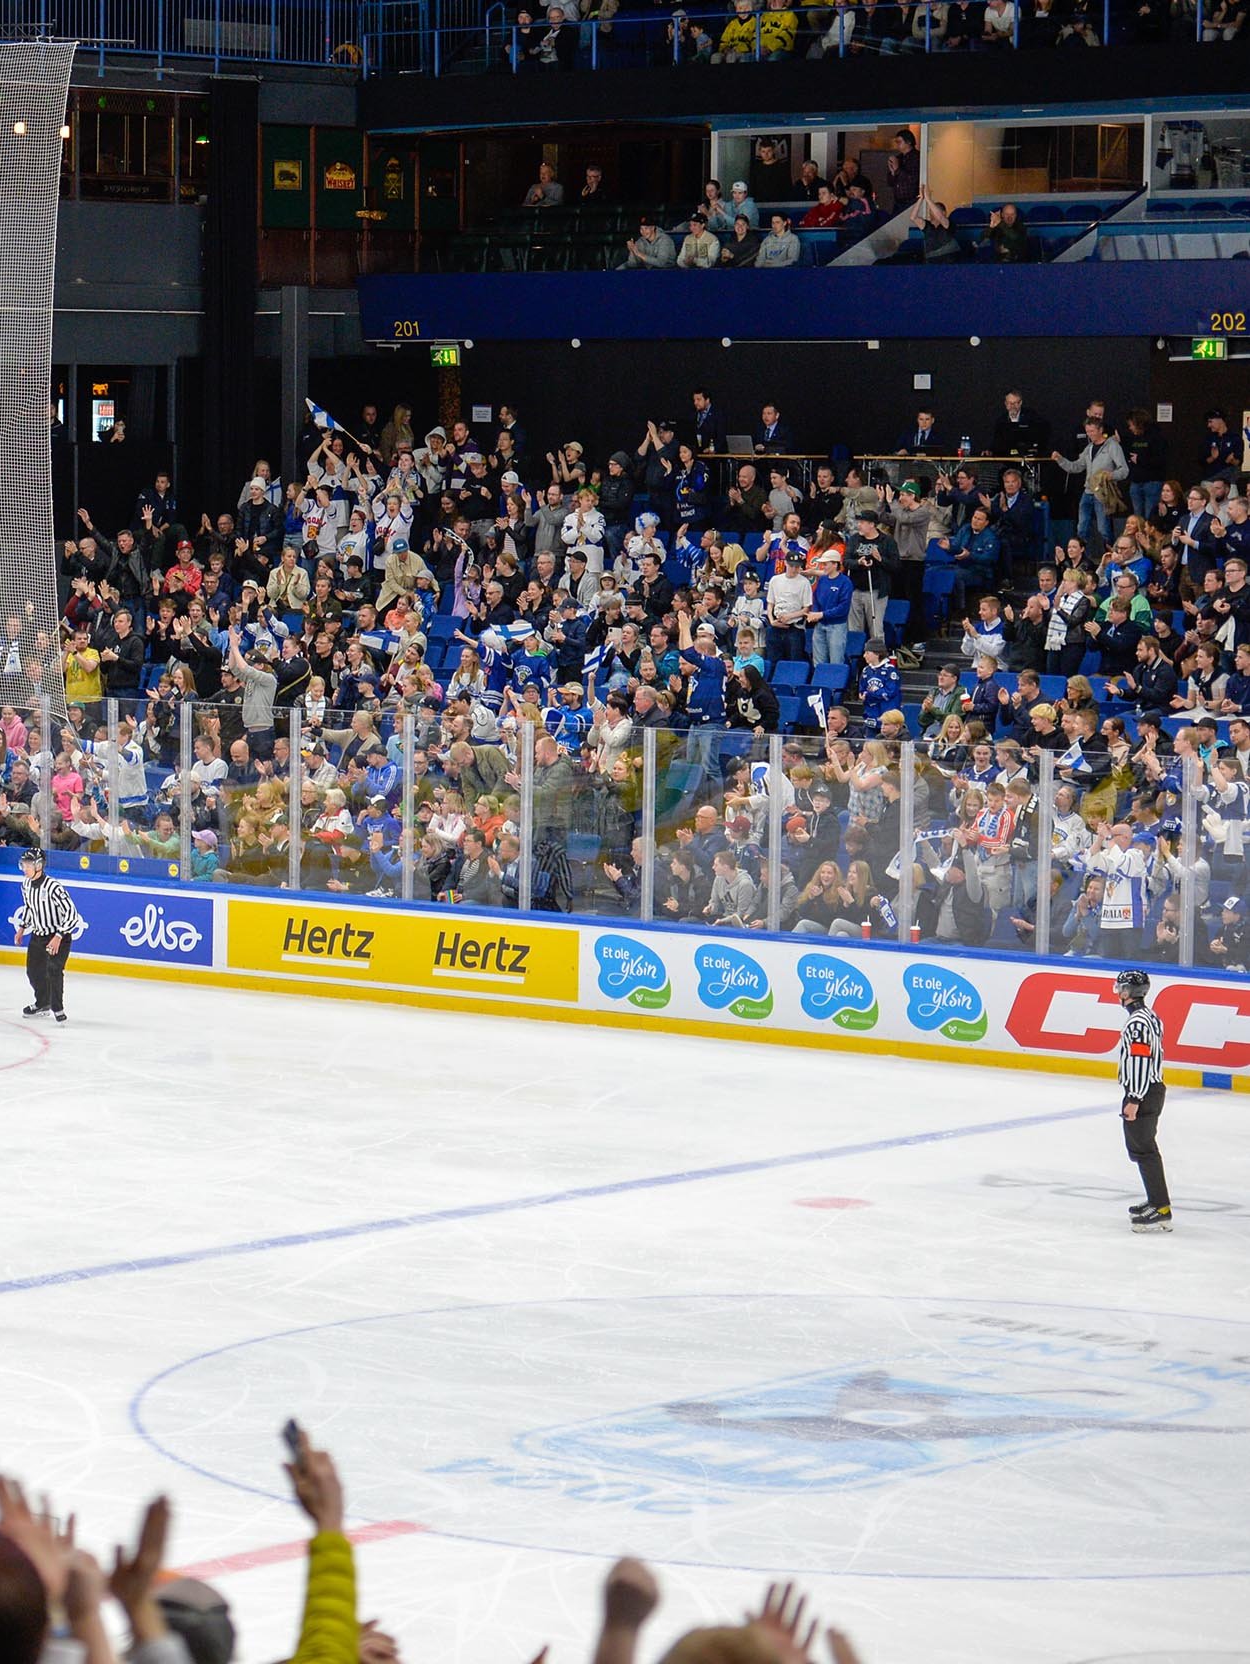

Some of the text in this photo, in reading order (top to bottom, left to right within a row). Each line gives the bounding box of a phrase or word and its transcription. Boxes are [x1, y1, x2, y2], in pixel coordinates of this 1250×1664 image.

[394, 320, 420, 337] 201
[1210, 312, 1247, 332] 202
[119, 903, 203, 952] elisa
[283, 918, 375, 959] Hertz
[434, 931, 531, 973] Hertz
[602, 946, 630, 961] Et ole
[702, 955, 731, 970] Et ole
[805, 965, 835, 980] Et ole
[912, 976, 942, 990] Et ole
